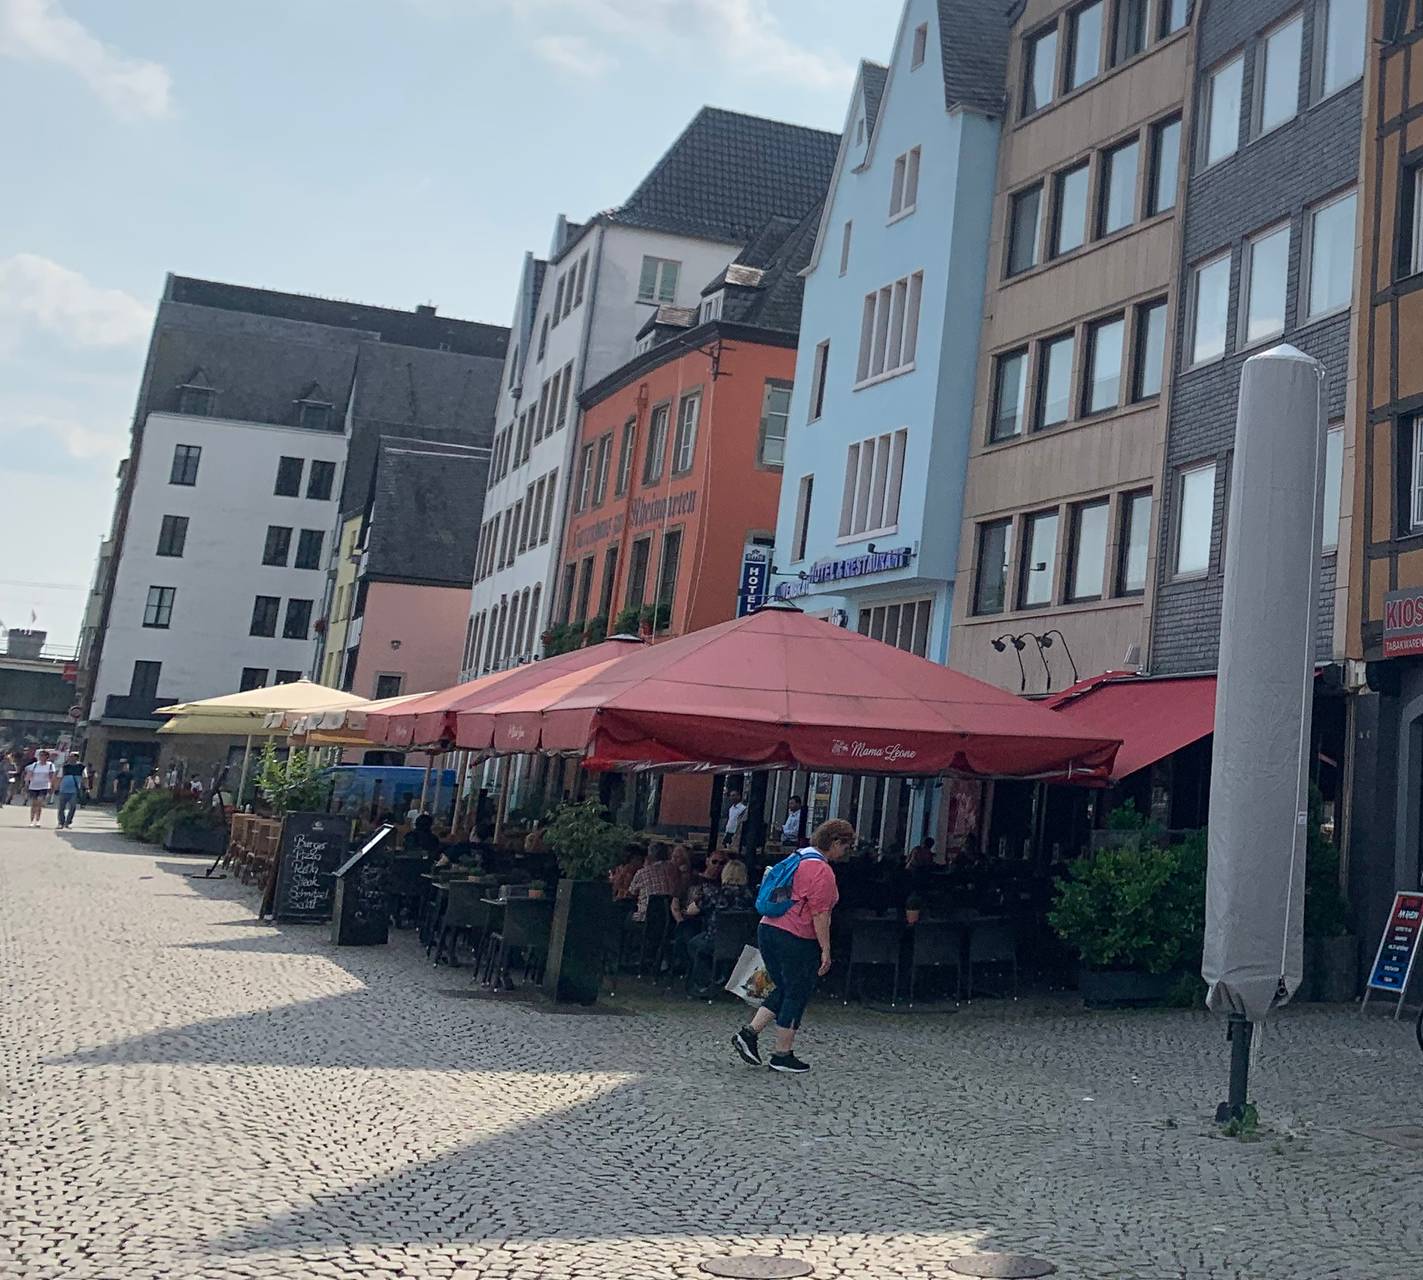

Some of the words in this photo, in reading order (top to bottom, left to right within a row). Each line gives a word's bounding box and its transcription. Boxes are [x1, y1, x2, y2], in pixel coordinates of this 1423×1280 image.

[809, 561, 835, 584] HOTEL
[747, 566, 759, 612] HOTEL
[1386, 637, 1423, 652] TABAKWAREN
[851, 740, 883, 758] Mama
[884, 743, 917, 761] Leone
[294, 833, 328, 857] Burger
